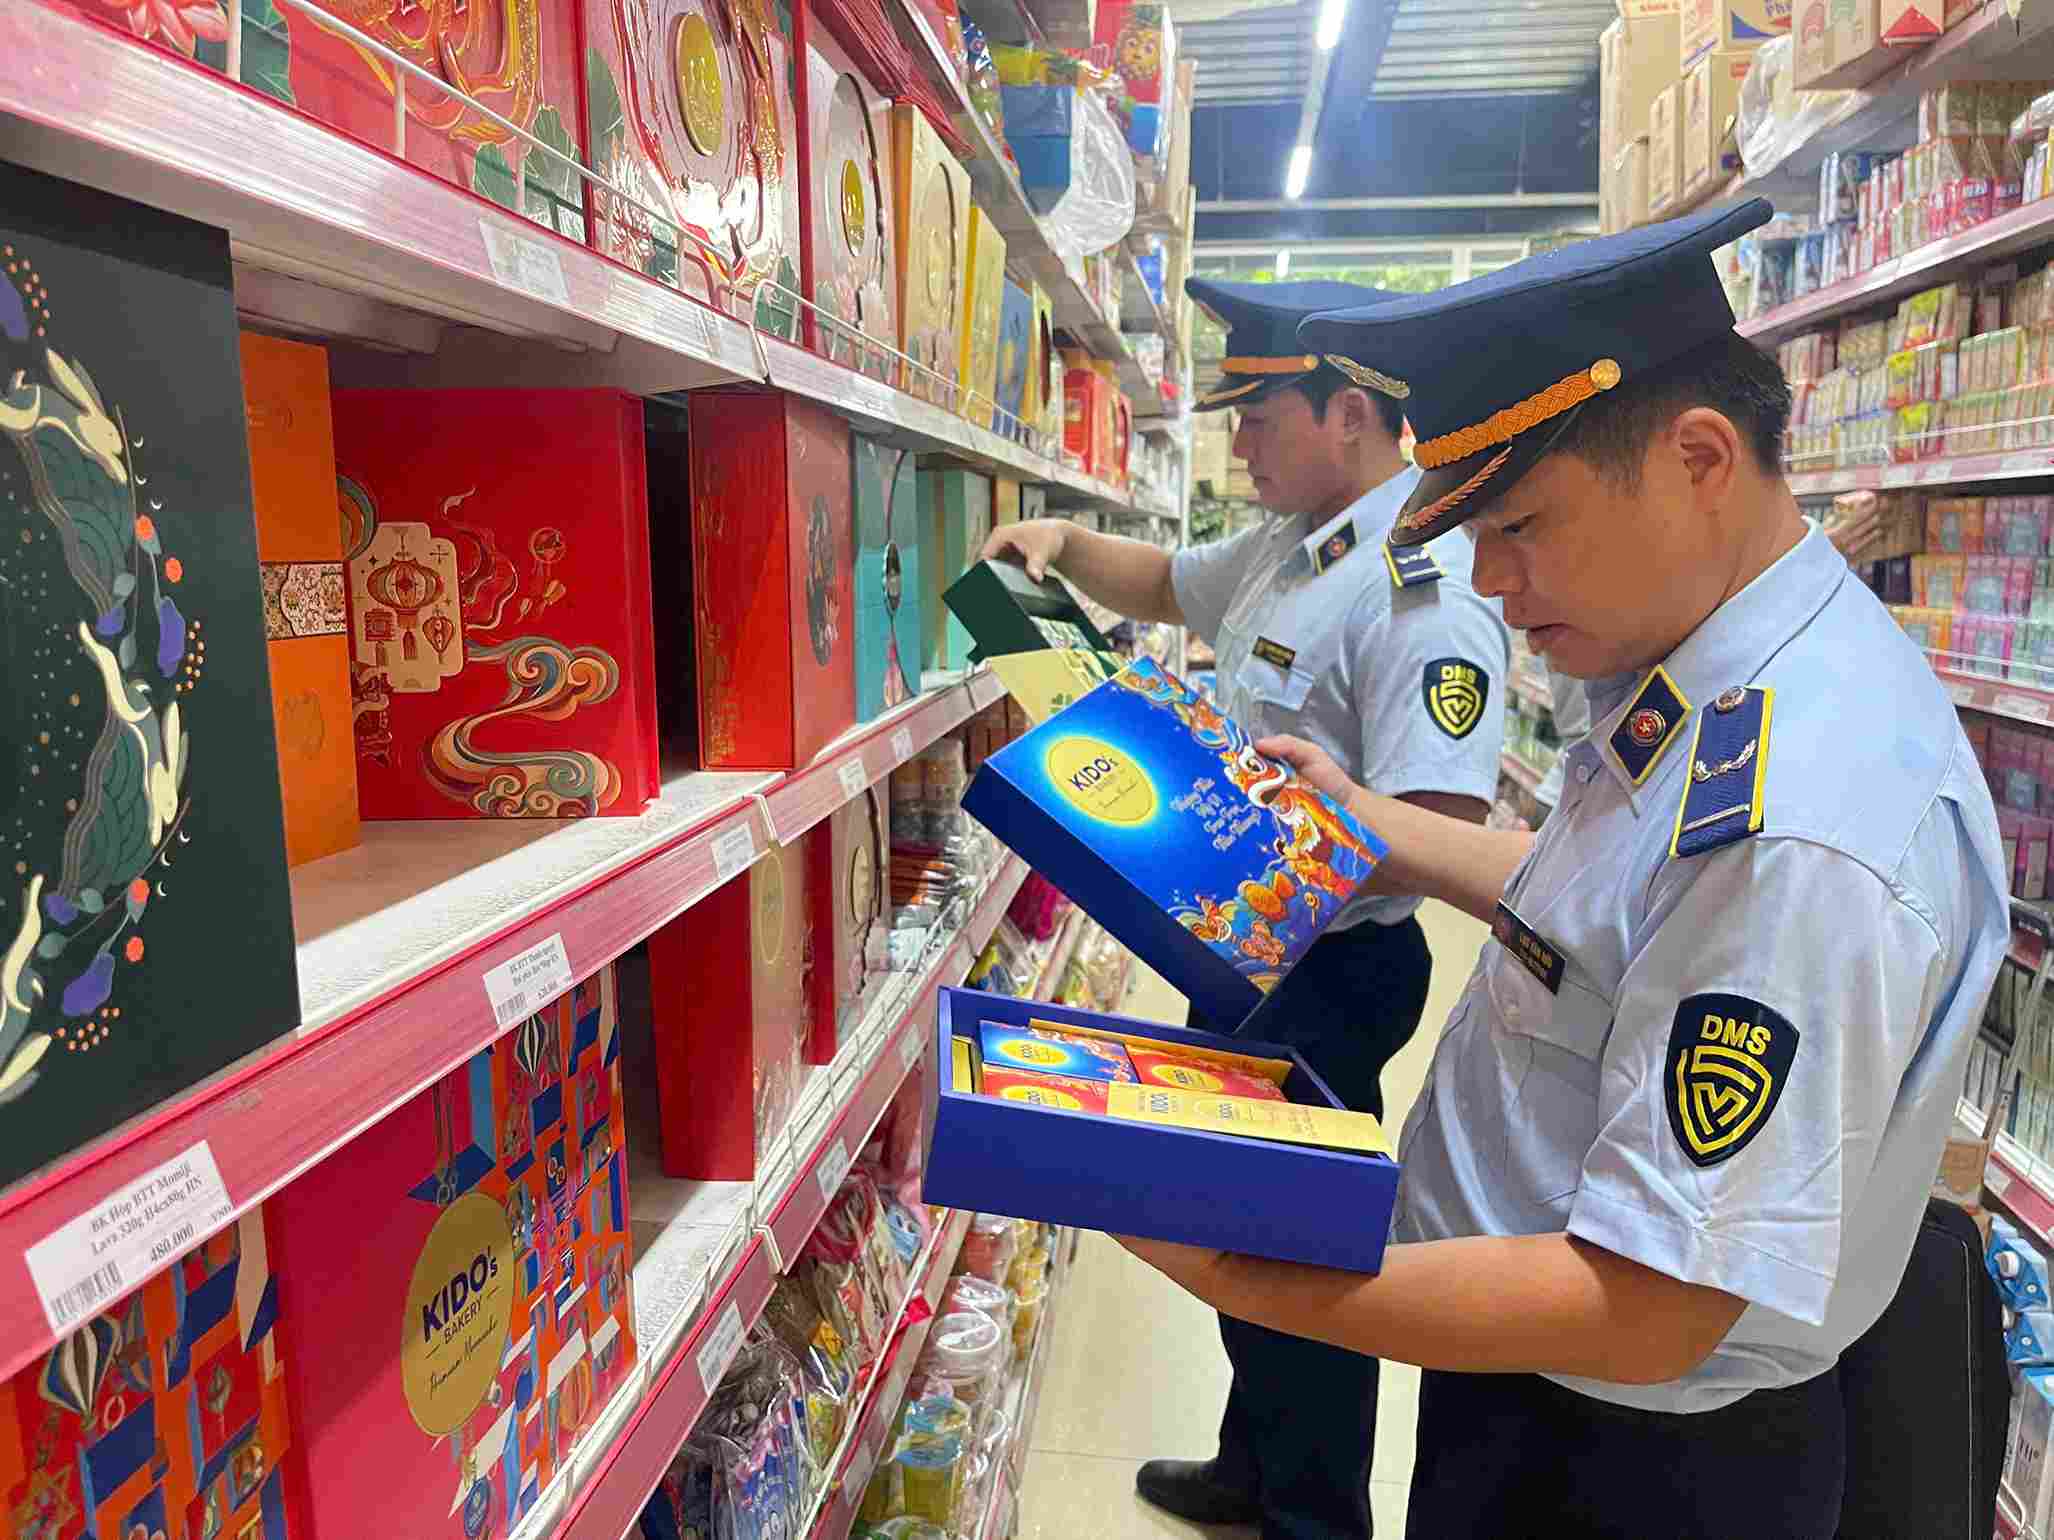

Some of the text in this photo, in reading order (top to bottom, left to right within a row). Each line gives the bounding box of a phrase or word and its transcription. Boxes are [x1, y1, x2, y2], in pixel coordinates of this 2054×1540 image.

[1441, 665, 1476, 684] DMS
[1701, 1014, 1771, 1055] DMS
[149, 1222, 195, 1263] 480.000
[422, 1246, 498, 1343] KIDO's
[444, 1295, 482, 1344] BAKERY
